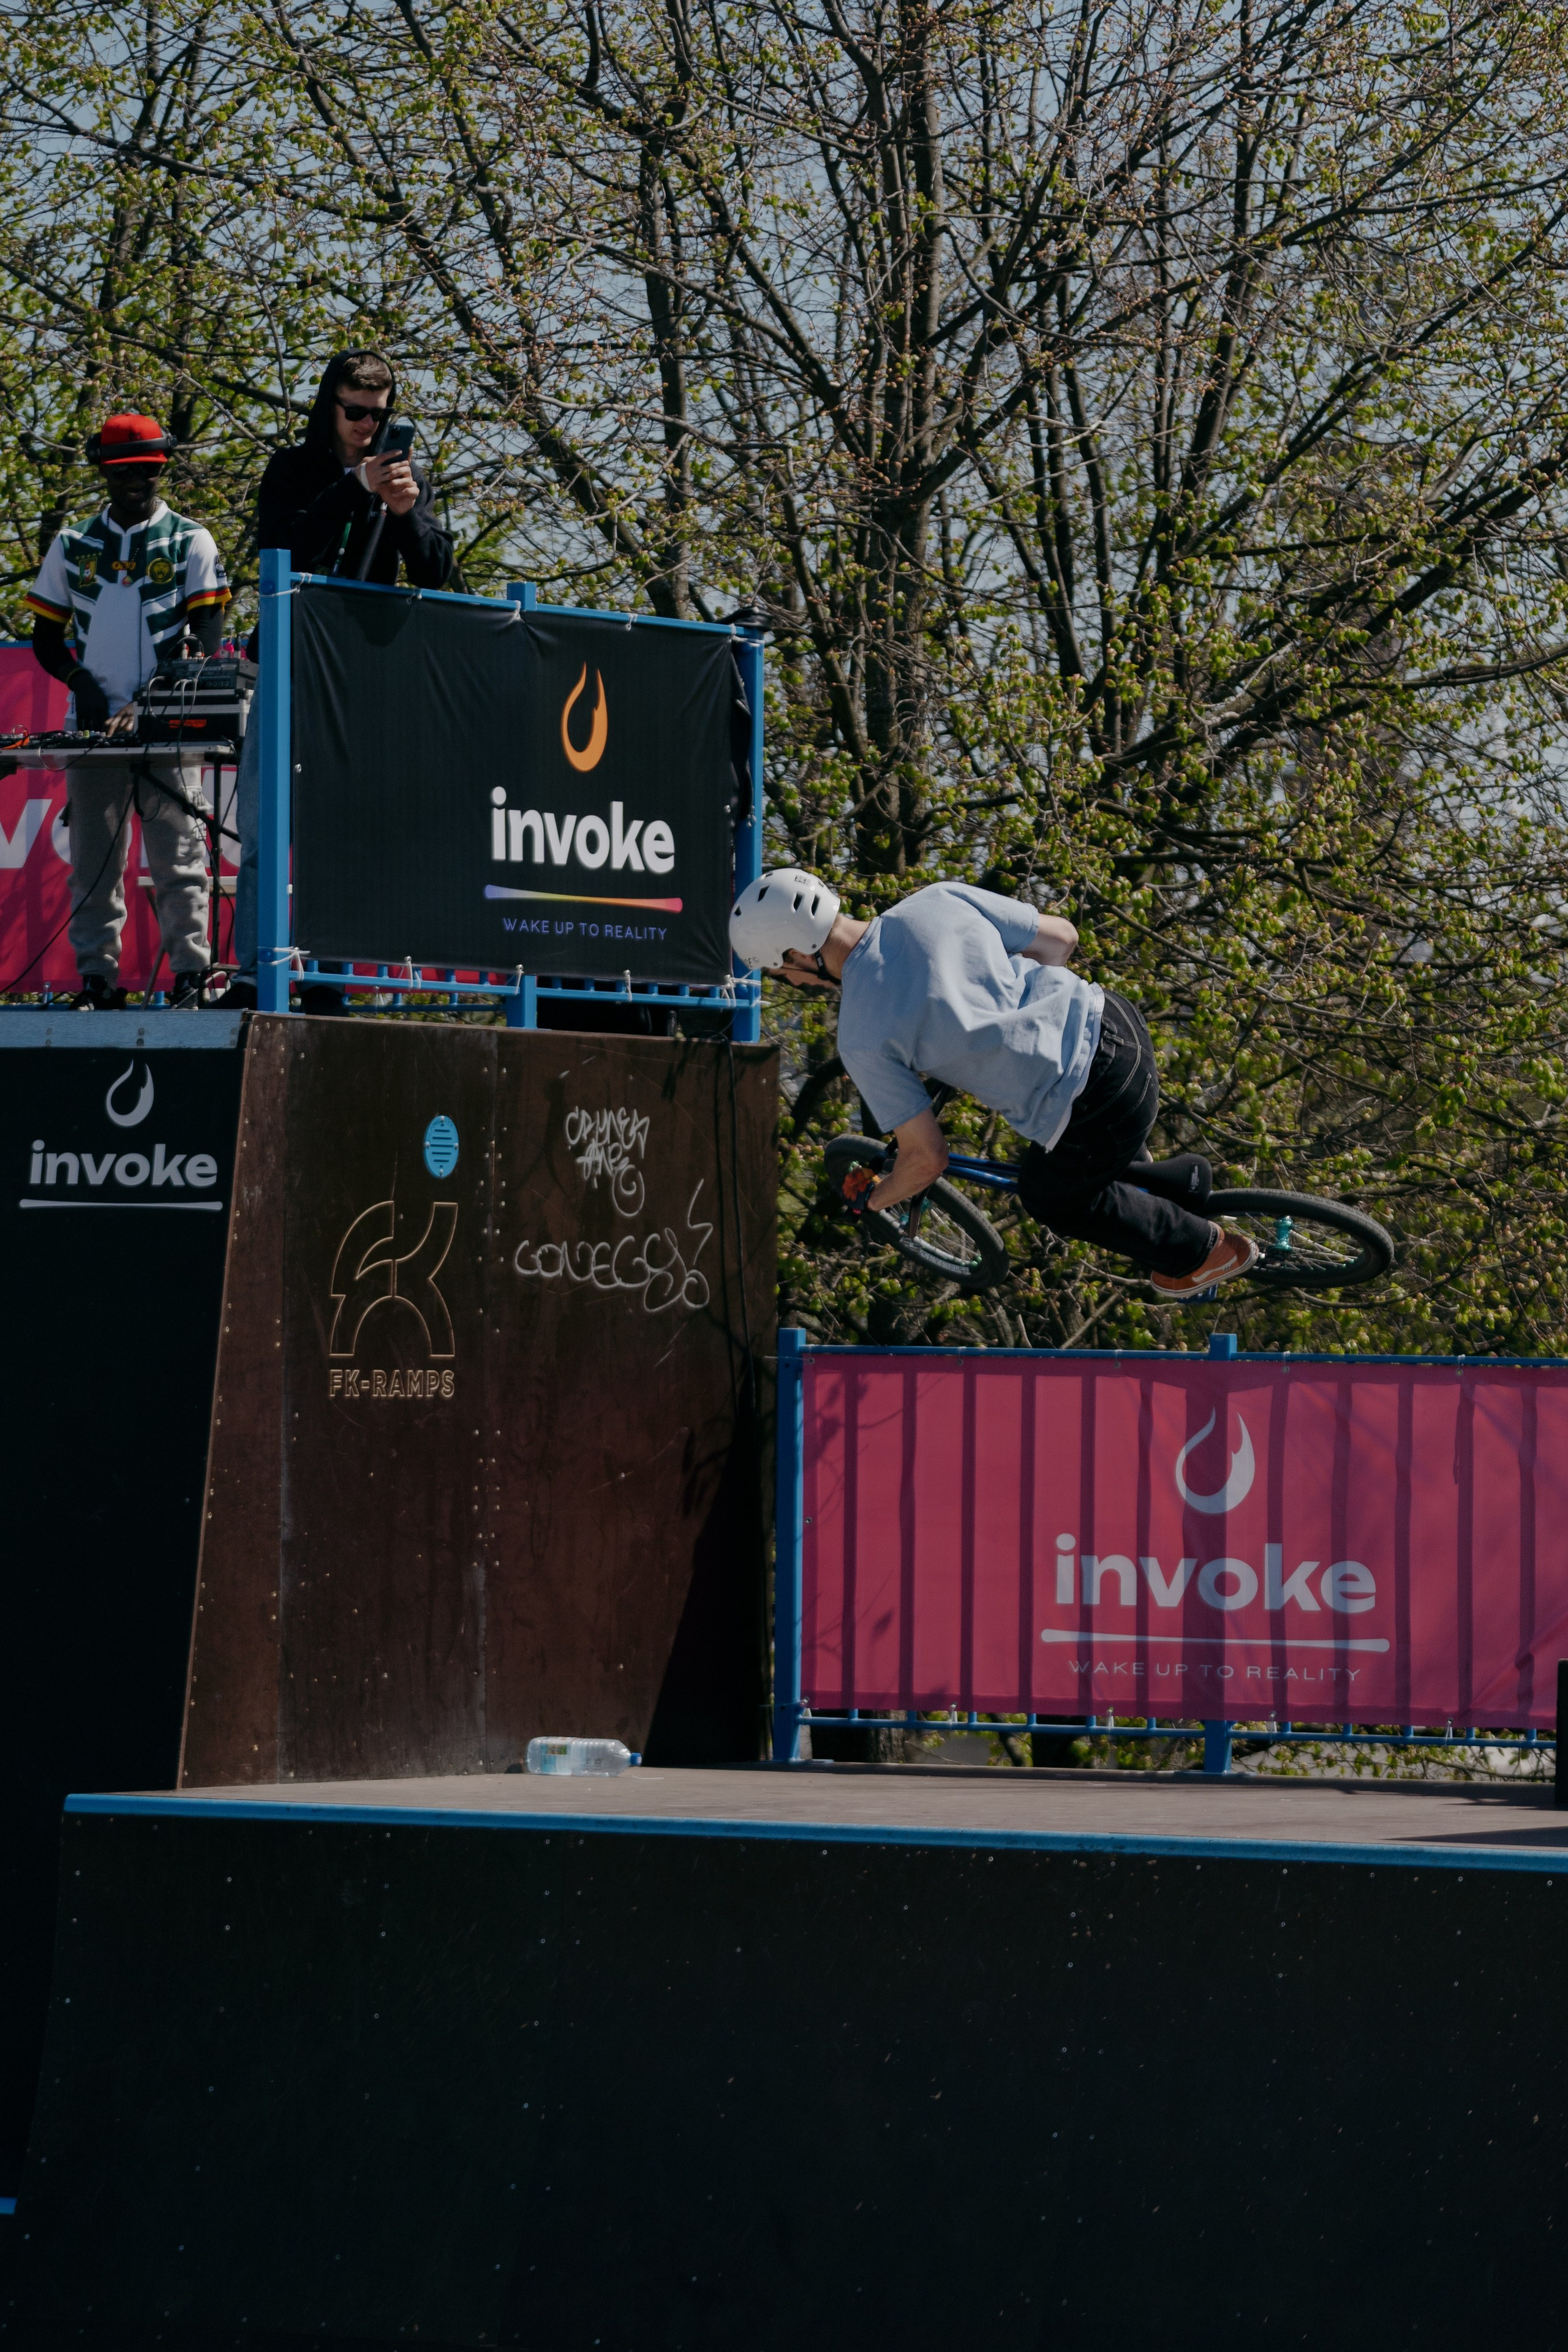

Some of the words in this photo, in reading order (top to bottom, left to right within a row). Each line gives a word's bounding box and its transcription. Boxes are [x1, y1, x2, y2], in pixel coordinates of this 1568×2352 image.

[491, 785, 676, 875] invoke
[502, 917, 549, 935] WAKE
[554, 920, 575, 935] UP
[579, 922, 600, 938] TO
[604, 923, 668, 941] REALITY
[29, 1139, 218, 1187] invoke
[328, 1368, 455, 1400] FK-RAMPS
[1054, 1532, 1377, 1614] invoke
[1067, 1659, 1145, 1676] WAKE
[1155, 1662, 1188, 1678] UP
[1199, 1664, 1235, 1681] TO
[1245, 1665, 1362, 1683] REALITY
